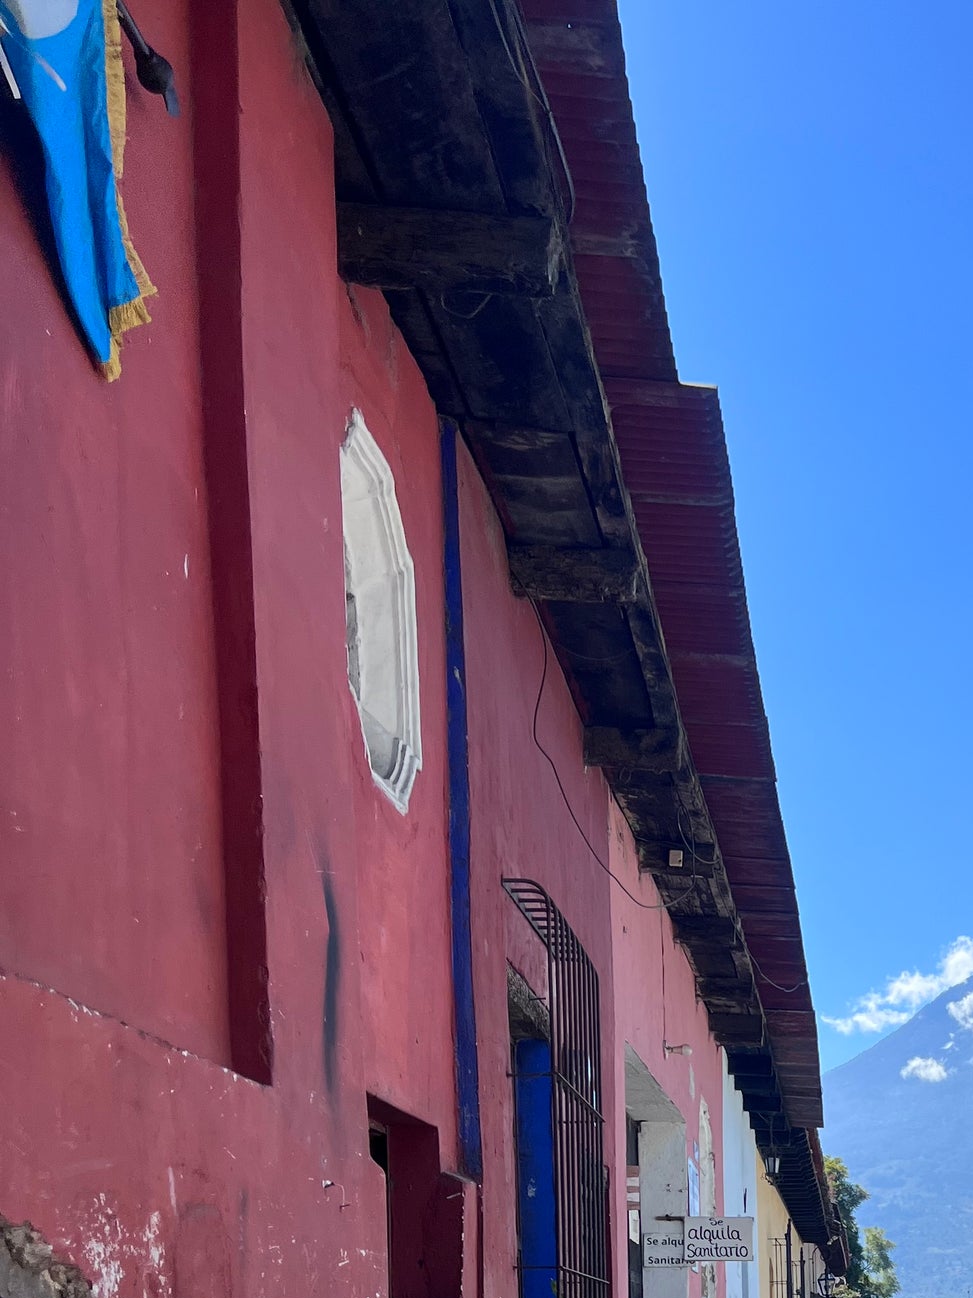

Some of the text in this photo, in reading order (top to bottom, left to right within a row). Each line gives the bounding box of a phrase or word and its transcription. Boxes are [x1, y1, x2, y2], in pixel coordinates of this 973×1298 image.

[708, 1217, 724, 1226] Se
[688, 1225, 742, 1245] alquila
[646, 1237, 684, 1247] Se alqu
[687, 1243, 748, 1258] Sanitario
